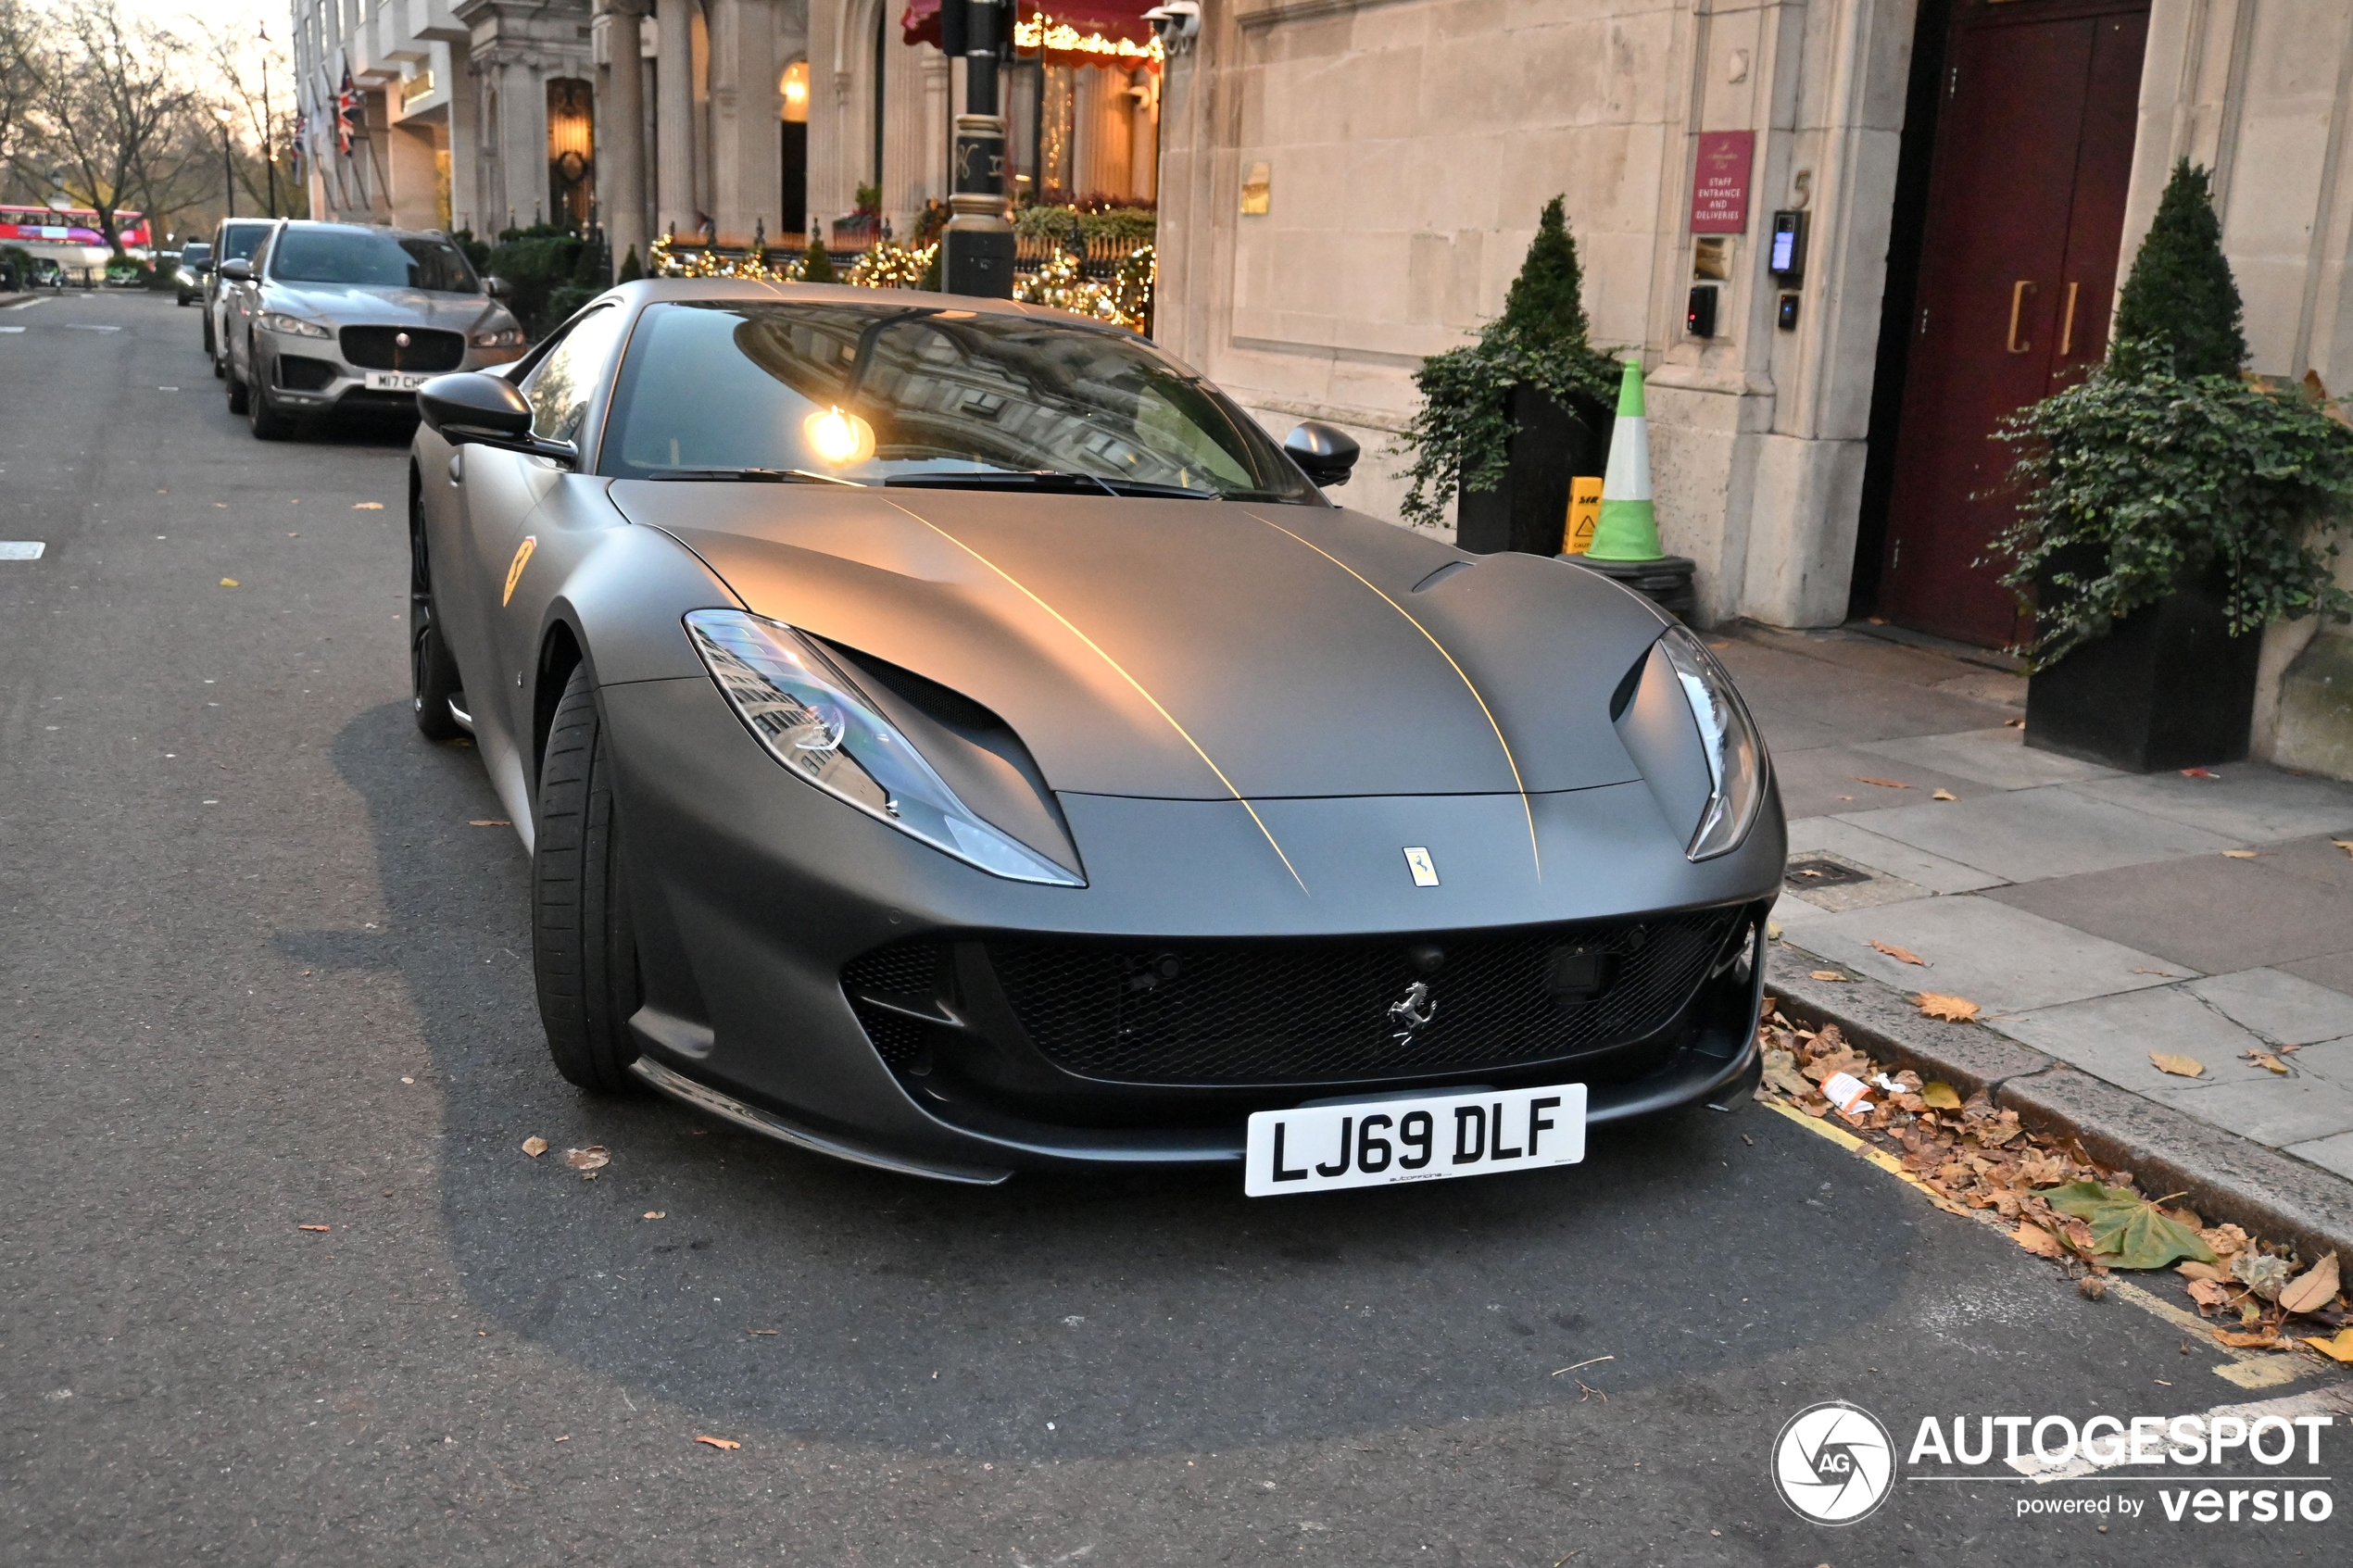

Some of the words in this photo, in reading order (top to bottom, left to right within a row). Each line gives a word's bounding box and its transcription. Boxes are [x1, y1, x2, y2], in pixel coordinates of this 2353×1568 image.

[1709, 177, 1732, 186] STAFF
[1698, 188, 1742, 198] ENTRANCE
[1709, 199, 1728, 209] AND
[1696, 210, 1739, 220] DELIVERIES
[1272, 1110, 1434, 1183] LJ69
[1452, 1096, 1561, 1165] DLF
